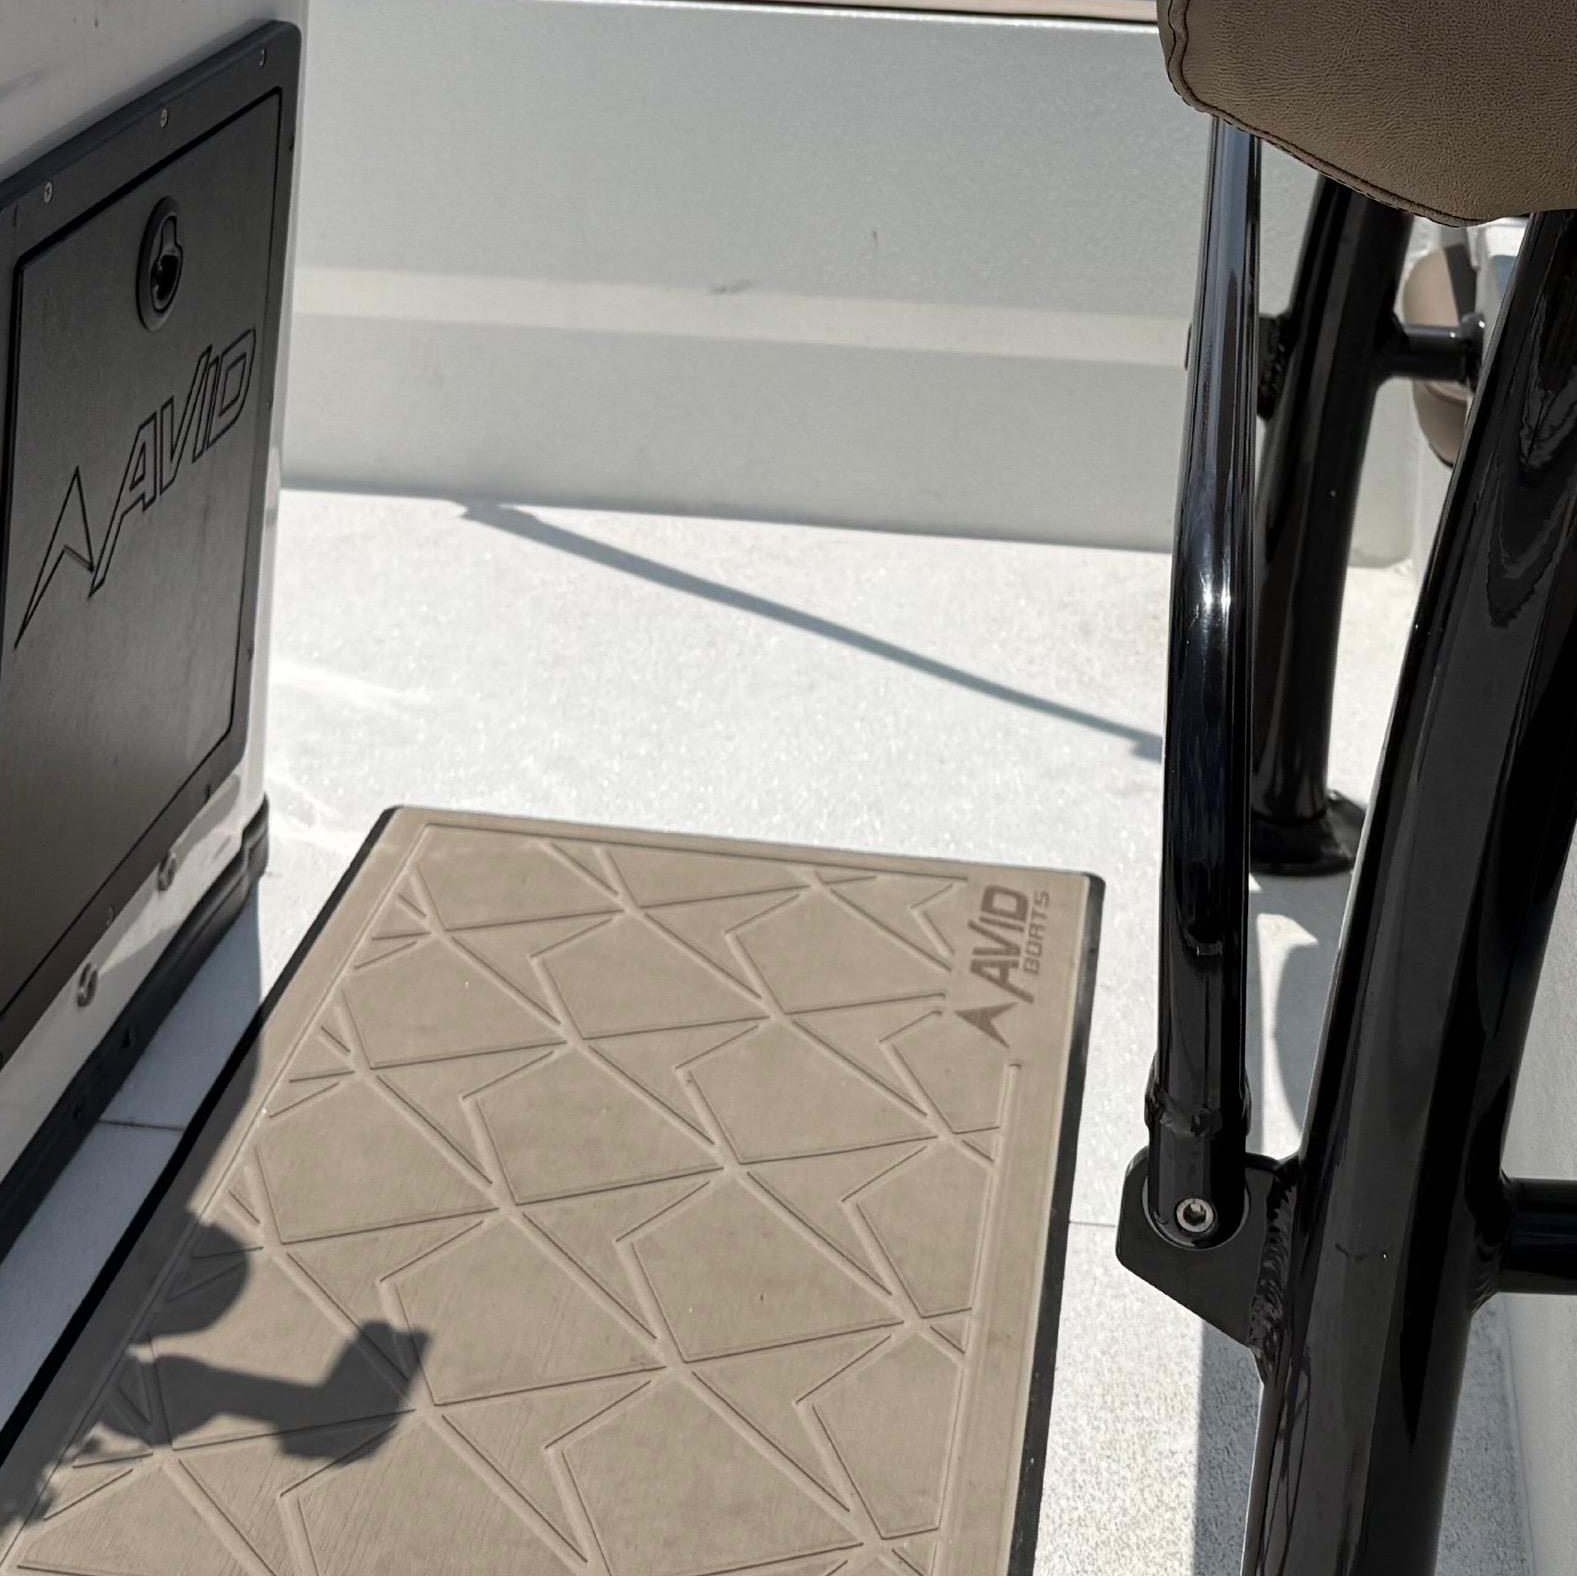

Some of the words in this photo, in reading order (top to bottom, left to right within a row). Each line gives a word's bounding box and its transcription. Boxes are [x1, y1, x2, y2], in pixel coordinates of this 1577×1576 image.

[89, 327, 256, 598] AVID
[967, 884, 1035, 1003] AVID
[1023, 889, 1050, 976] BOATS
